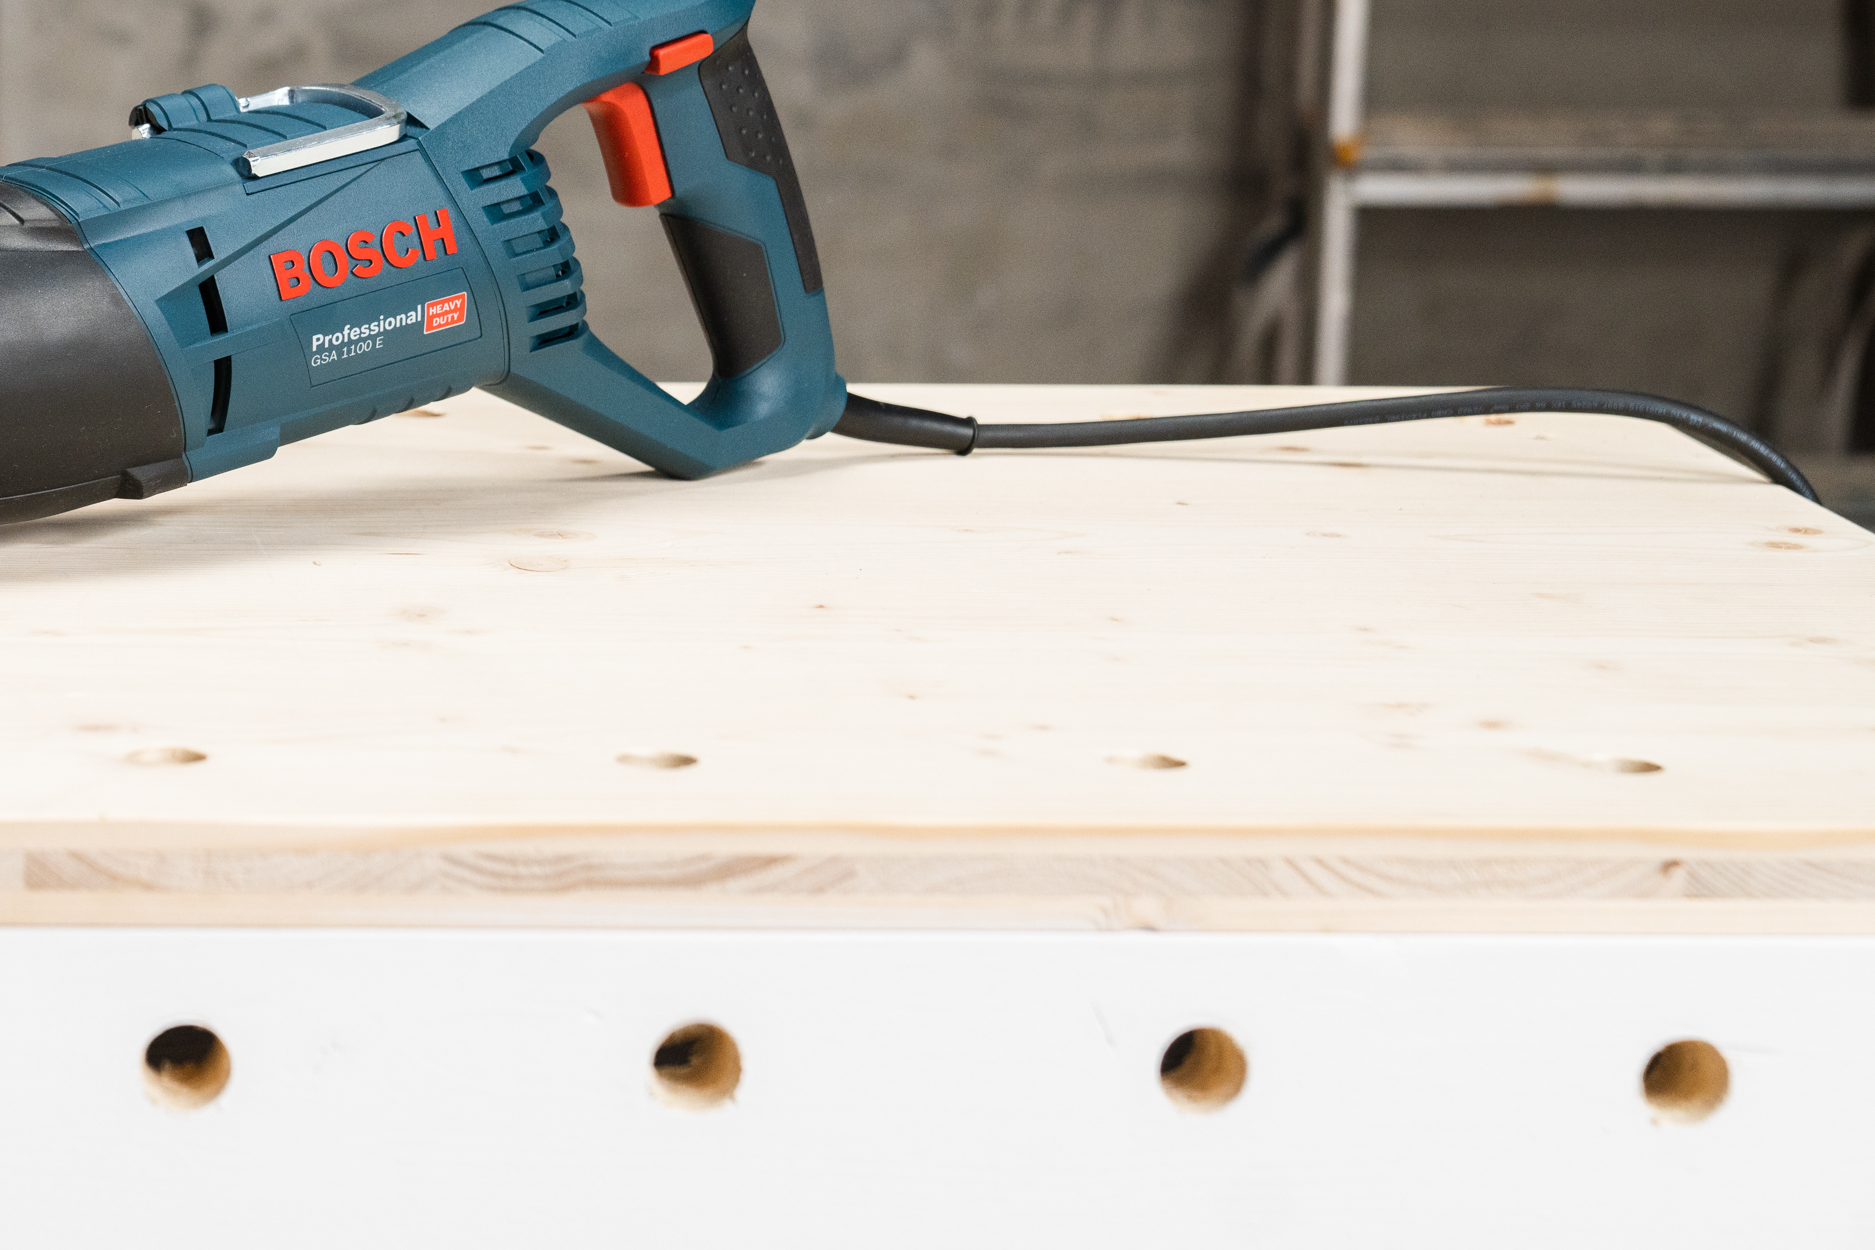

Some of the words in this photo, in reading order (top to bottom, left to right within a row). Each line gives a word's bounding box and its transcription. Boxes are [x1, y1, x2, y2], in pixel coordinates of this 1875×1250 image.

[270, 208, 458, 301] BOSCH
[429, 298, 462, 316] HEAVY
[432, 311, 460, 327] DUTY
[312, 304, 422, 352] Professional
[311, 350, 338, 367] GSA
[341, 339, 373, 359] 1100
[375, 336, 384, 349] E
